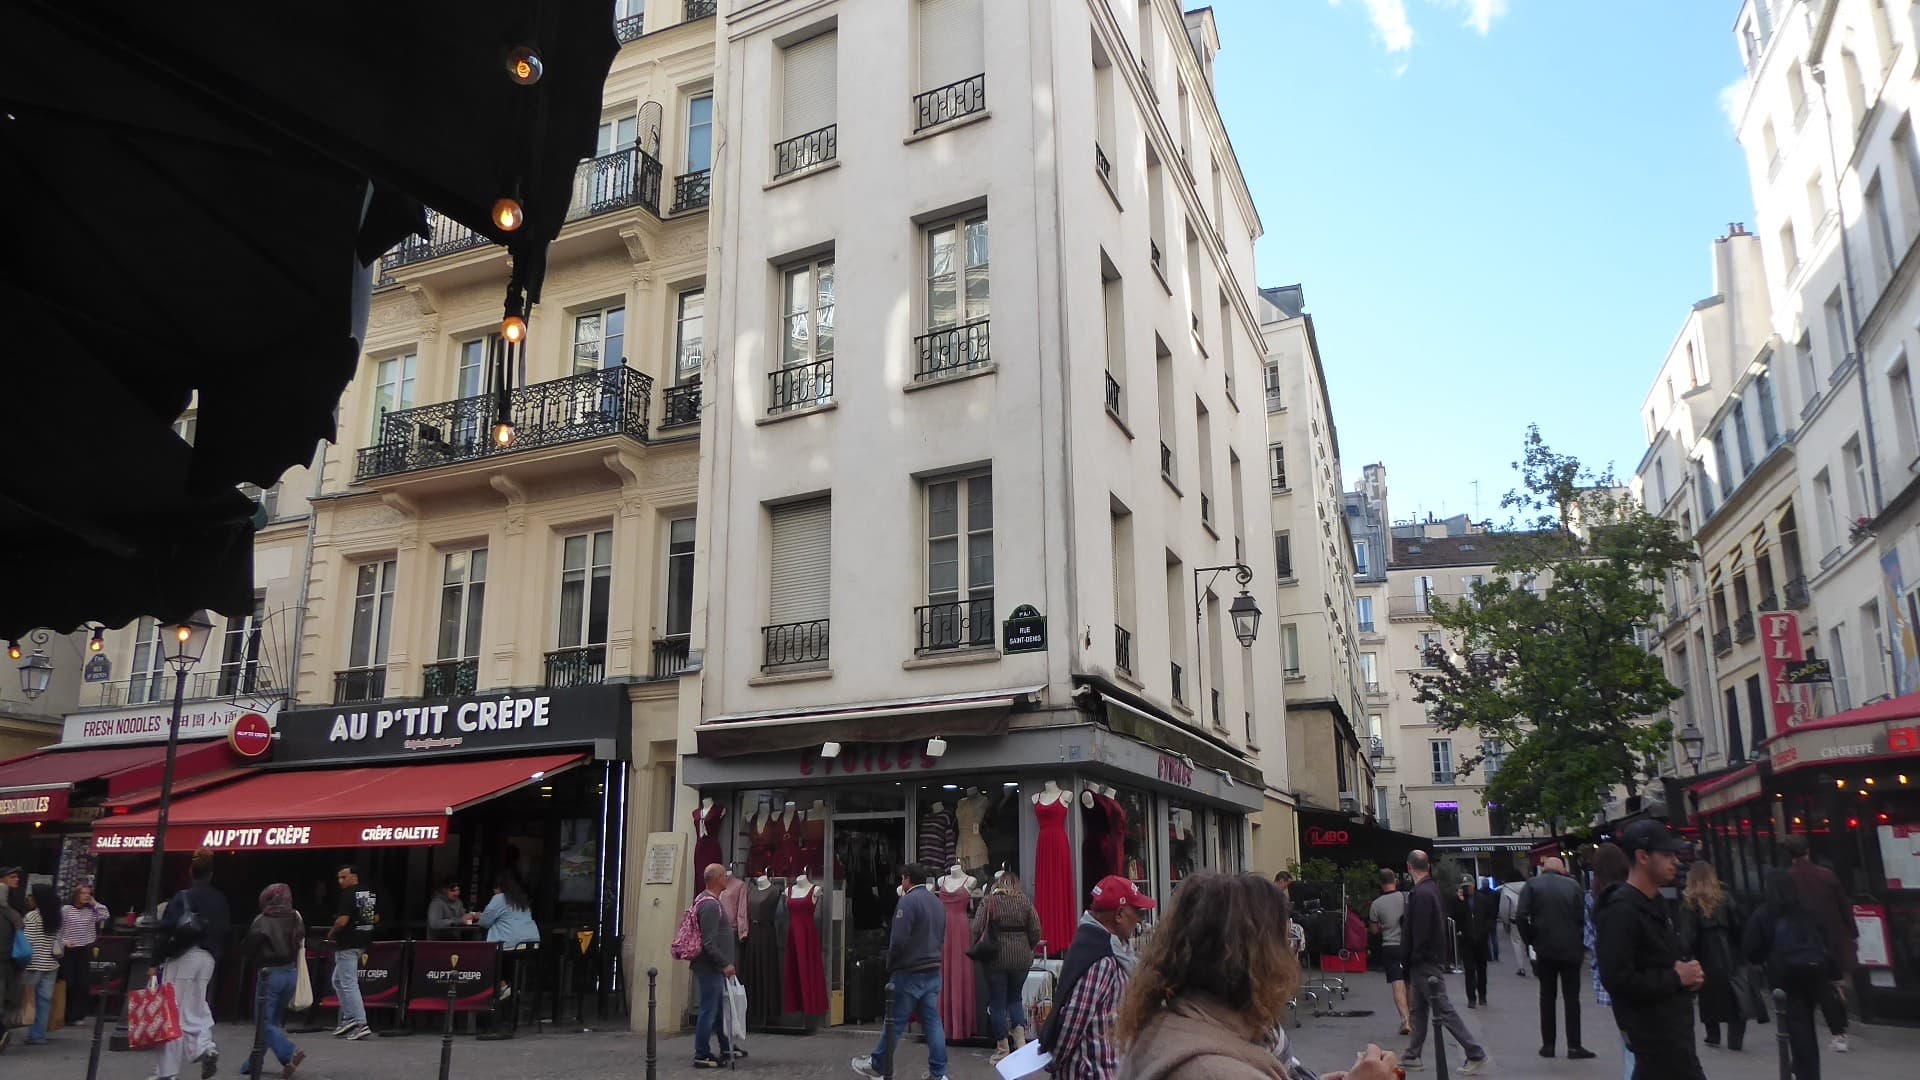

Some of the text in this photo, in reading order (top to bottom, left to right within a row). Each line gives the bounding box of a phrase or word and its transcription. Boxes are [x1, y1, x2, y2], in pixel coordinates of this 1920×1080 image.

[1019, 626, 1031, 634] RUE
[1009, 635, 1042, 645] SAINT-DENIS
[83, 715, 161, 737] FRESH NOODLES
[330, 695, 550, 742] AU P'TIT CRÊPE
[1821, 743, 1874, 758] CHOUFFE
[96, 832, 155, 847] SALÉE SUCRÉE
[203, 825, 312, 847] AU P'TIT CRÊPE
[361, 825, 440, 841] CRÊPE GALETTE
